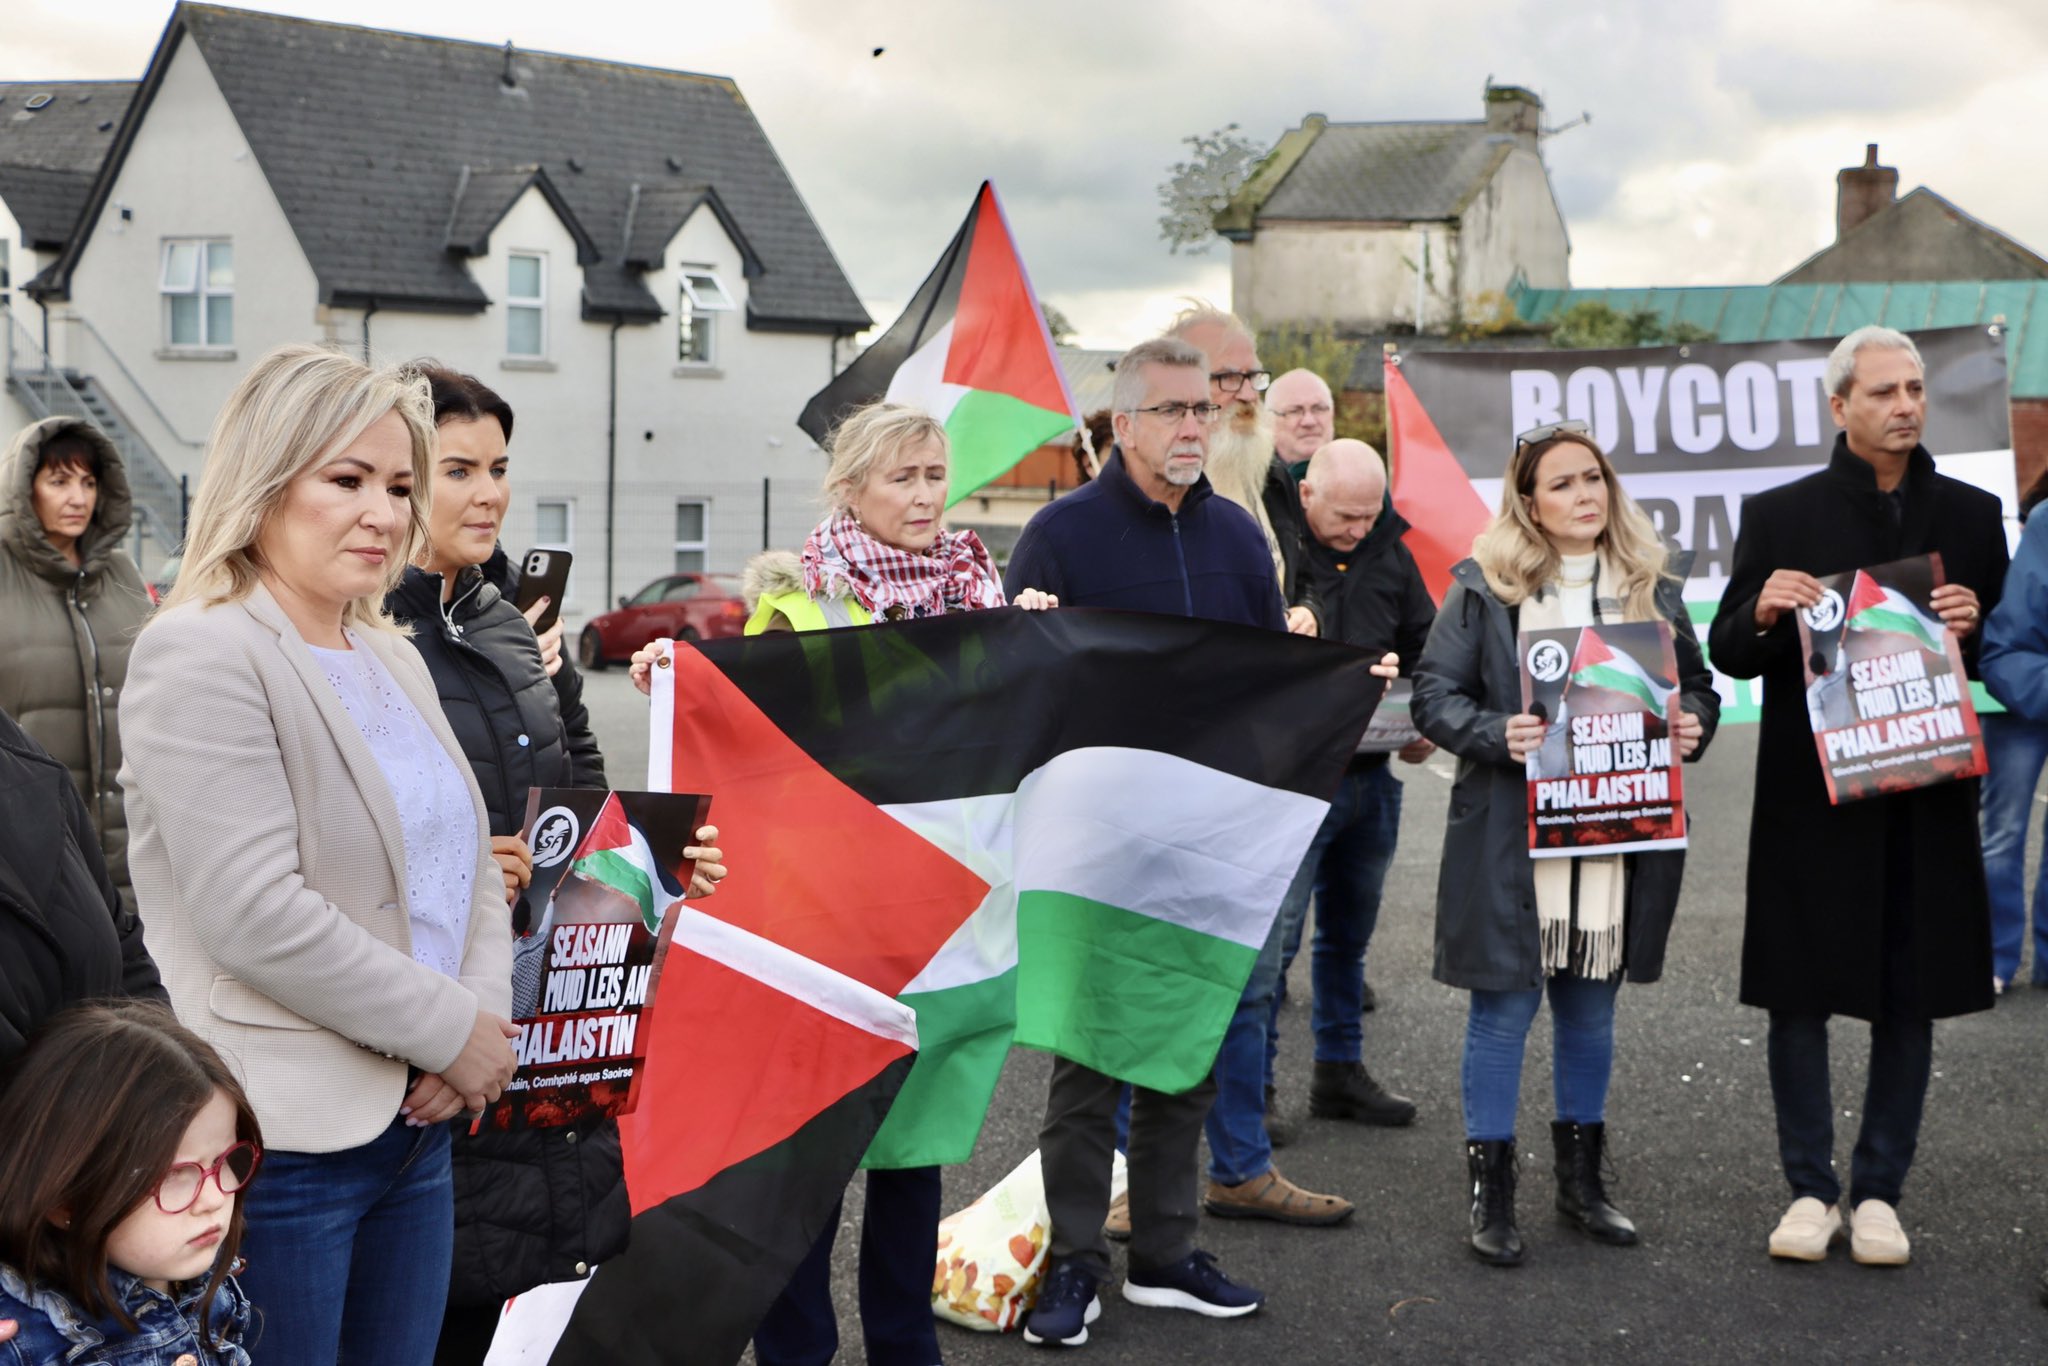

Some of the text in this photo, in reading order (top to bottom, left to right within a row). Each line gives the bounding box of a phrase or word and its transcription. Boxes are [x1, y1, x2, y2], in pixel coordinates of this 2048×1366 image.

[1510, 359, 1829, 454] BOYCOT
[1851, 650, 1926, 691] SEASANN
[1856, 672, 1962, 720] MUID LEIS AN
[1572, 712, 1644, 745] SEASANN
[1824, 704, 1965, 762] PHALAISTÍN
[1573, 738, 1671, 774] MUID LEIS AN
[1536, 767, 1669, 810] PHALAISTÍN
[551, 924, 633, 968] SEASANN
[543, 965, 652, 1013] MUID LEIS AN
[511, 1006, 638, 1066] HALAISTÍN
[532, 1070, 578, 1089] Comhphlé
[578, 1071, 601, 1085] agus
[601, 1067, 633, 1081] Saoirse
